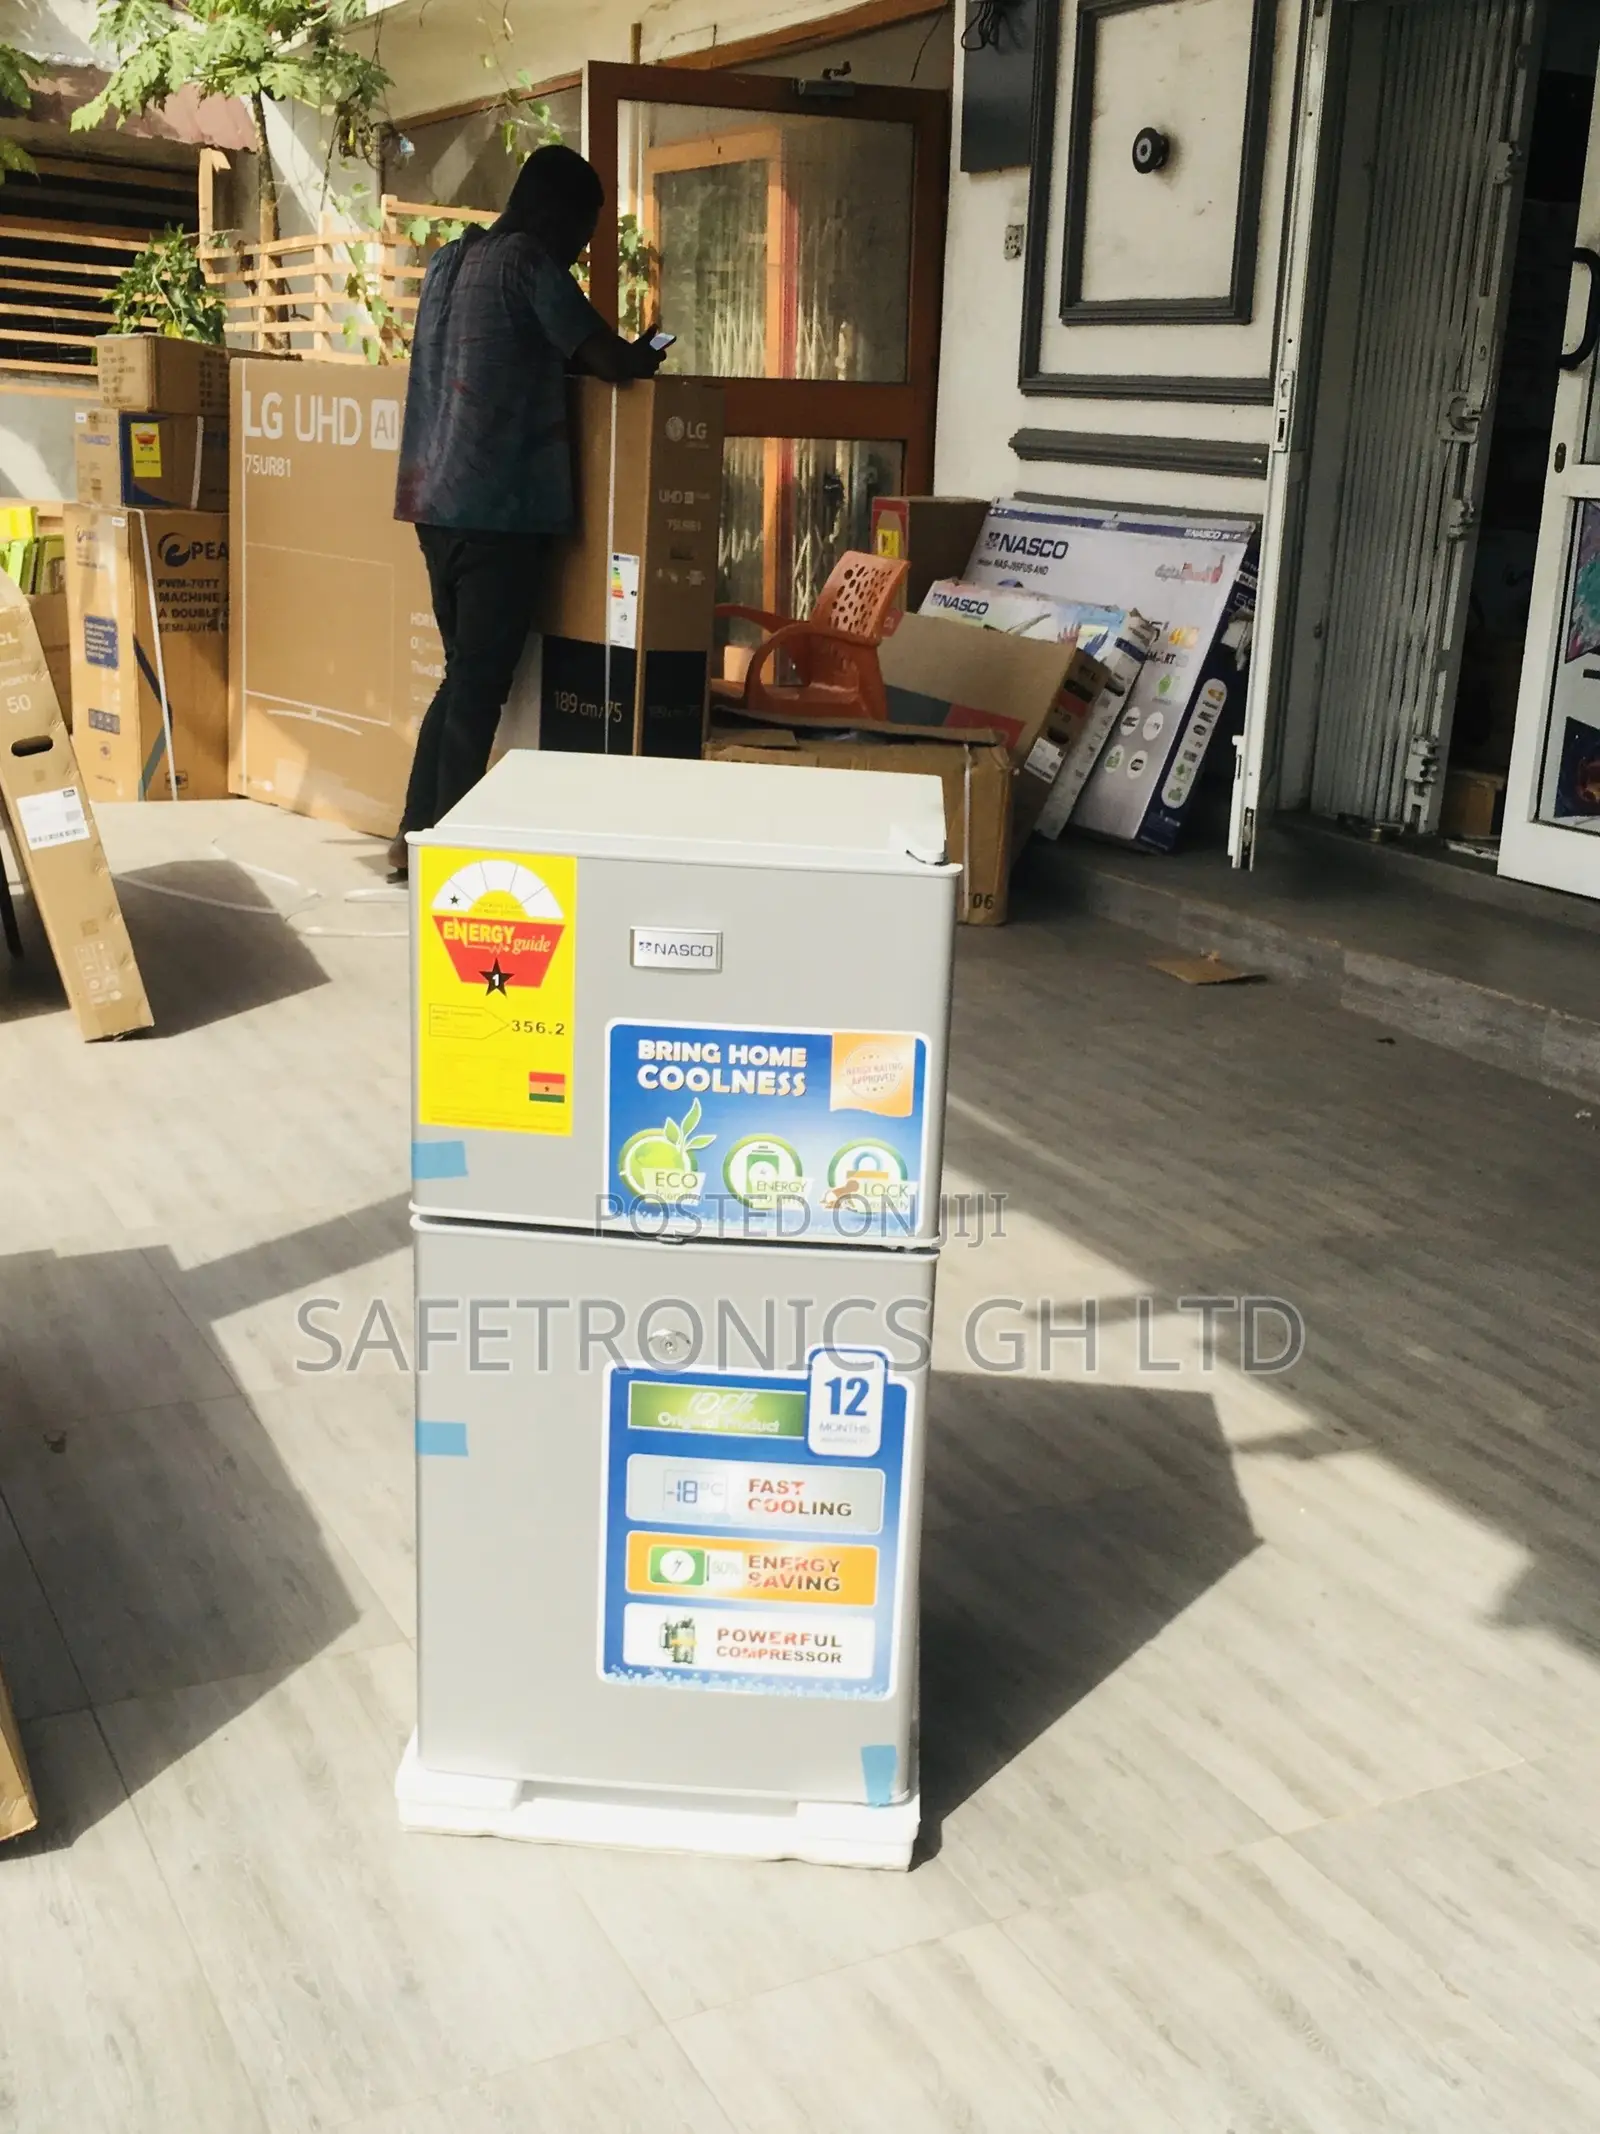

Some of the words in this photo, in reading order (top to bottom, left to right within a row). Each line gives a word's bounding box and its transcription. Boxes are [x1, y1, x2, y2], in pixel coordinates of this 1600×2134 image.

[243, 390, 283, 440] LG
[294, 395, 363, 446] UHD
[372, 402, 399, 444] AI
[686, 420, 708, 439] LG
[245, 454, 292, 478] 75UR81
[1191, 528, 1222, 540] NASCO
[999, 533, 1069, 560] NASCO
[158, 591, 220, 604] MACHINE
[938, 593, 990, 616] NASCO
[159, 608, 168, 618] A
[171, 608, 219, 618] DOUBLE
[6, 693, 32, 715] 50
[553, 690, 579, 714] 189
[972, 892, 994, 911] 06
[443, 917, 515, 946] ENERGY
[512, 934, 552, 956] guide
[654, 942, 714, 958] NASCO
[492, 973, 501, 986] 1
[511, 1019, 566, 1037] 356.2
[637, 1039, 721, 1064] BRING
[729, 1043, 807, 1068] HOME
[637, 1064, 807, 1098] COOLNESS
[655, 1171, 698, 1189] ECO
[756, 1179, 807, 1194] ENERGY
[864, 1182, 909, 1199] LOCK
[824, 1376, 870, 1417] 12
[819, 1421, 871, 1436] MONTHS
[749, 1478, 805, 1497] FAST
[747, 1498, 853, 1518] COOLING
[748, 1555, 841, 1574] ENERGY
[748, 1573, 841, 1593] SAVING
[716, 1628, 843, 1648] POWERFUL
[716, 1646, 843, 1664] COMPRESSOR
